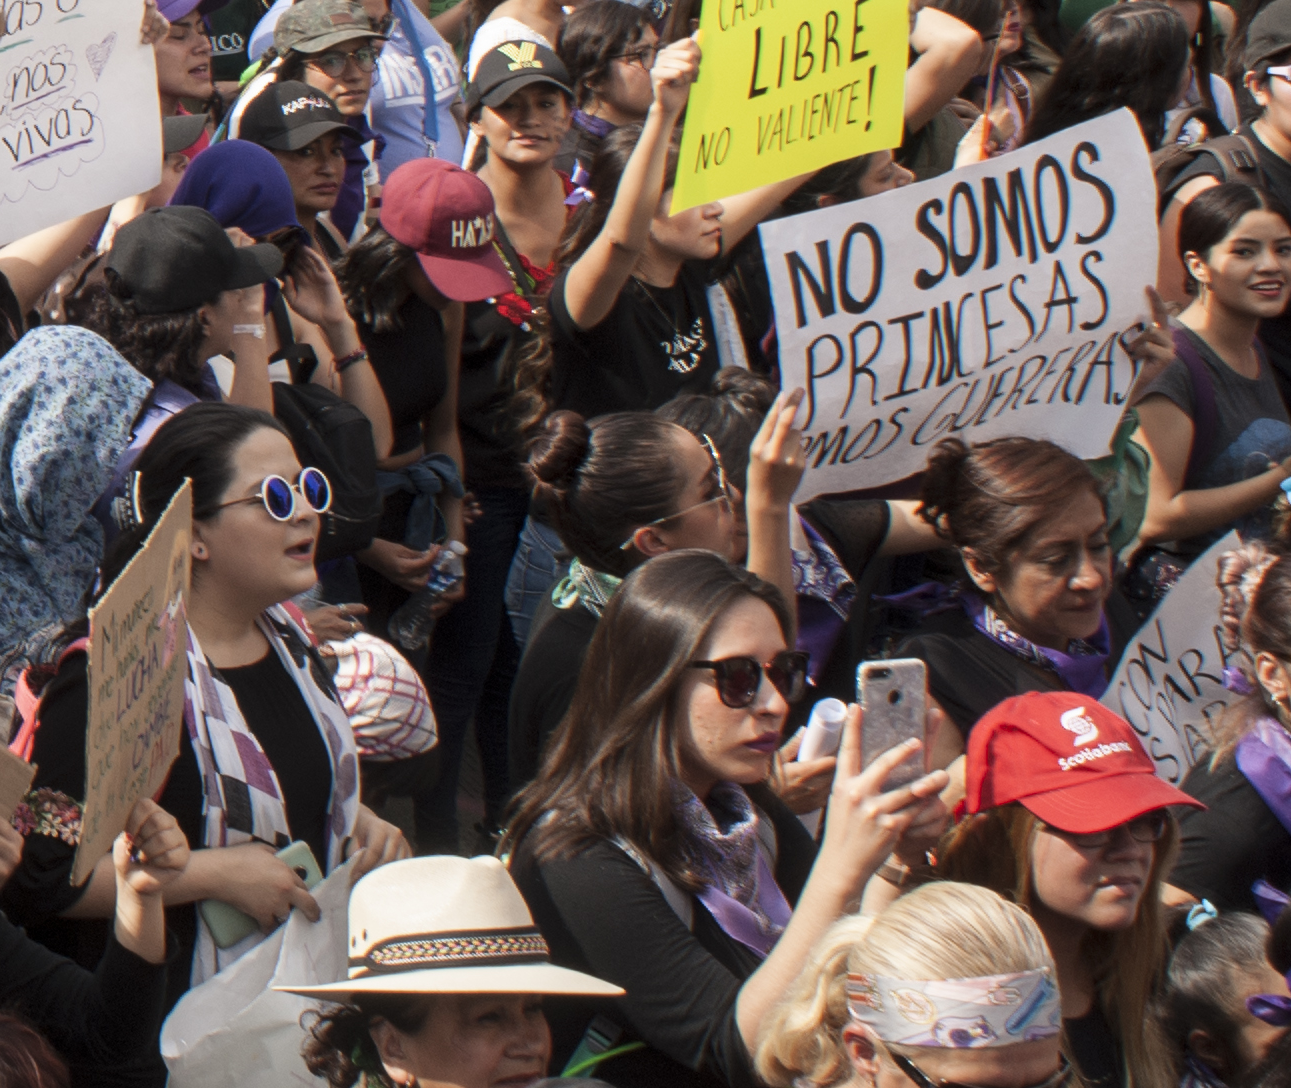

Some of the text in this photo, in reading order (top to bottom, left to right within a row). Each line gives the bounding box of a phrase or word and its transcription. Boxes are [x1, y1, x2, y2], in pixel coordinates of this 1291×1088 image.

[9, 51, 68, 104] nos
[694, 63, 877, 175] NO VALIENTE!
[1, 97, 96, 164] vivas
[784, 140, 1117, 330] NO SOMOS
[802, 249, 1111, 432] PRINCESAS
[1057, 740, 1132, 772] Scotiabank
